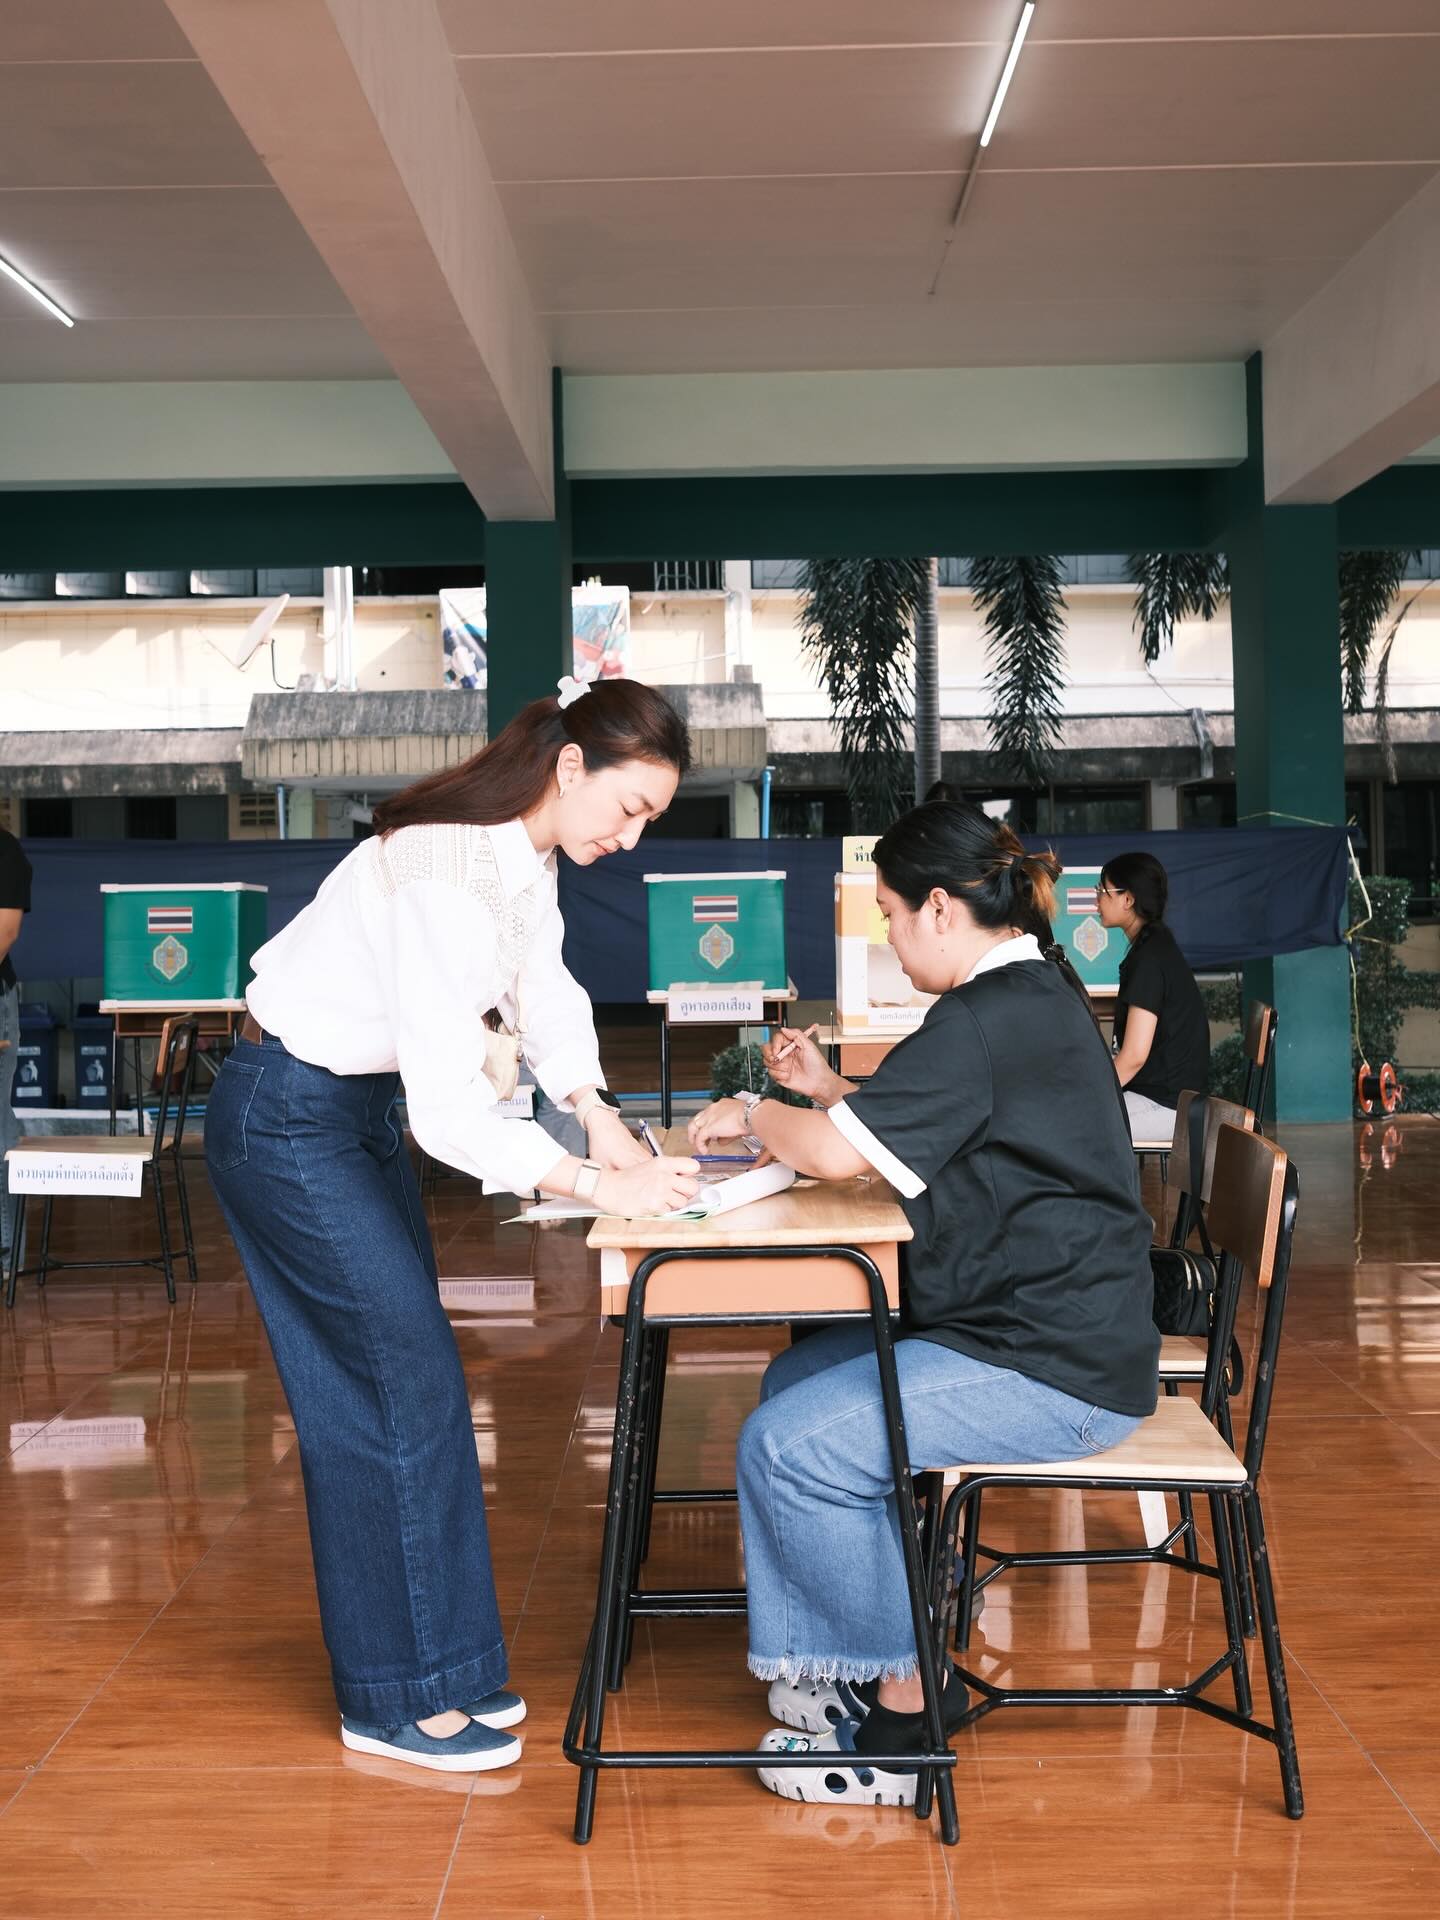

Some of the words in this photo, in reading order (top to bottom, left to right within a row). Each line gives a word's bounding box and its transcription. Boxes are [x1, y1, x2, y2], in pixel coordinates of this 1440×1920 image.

[680, 997, 752, 1016] คูหาออกเสียง
[17, 1162, 135, 1185] ควบคุมหีบบัตรเลือกตั้ง
